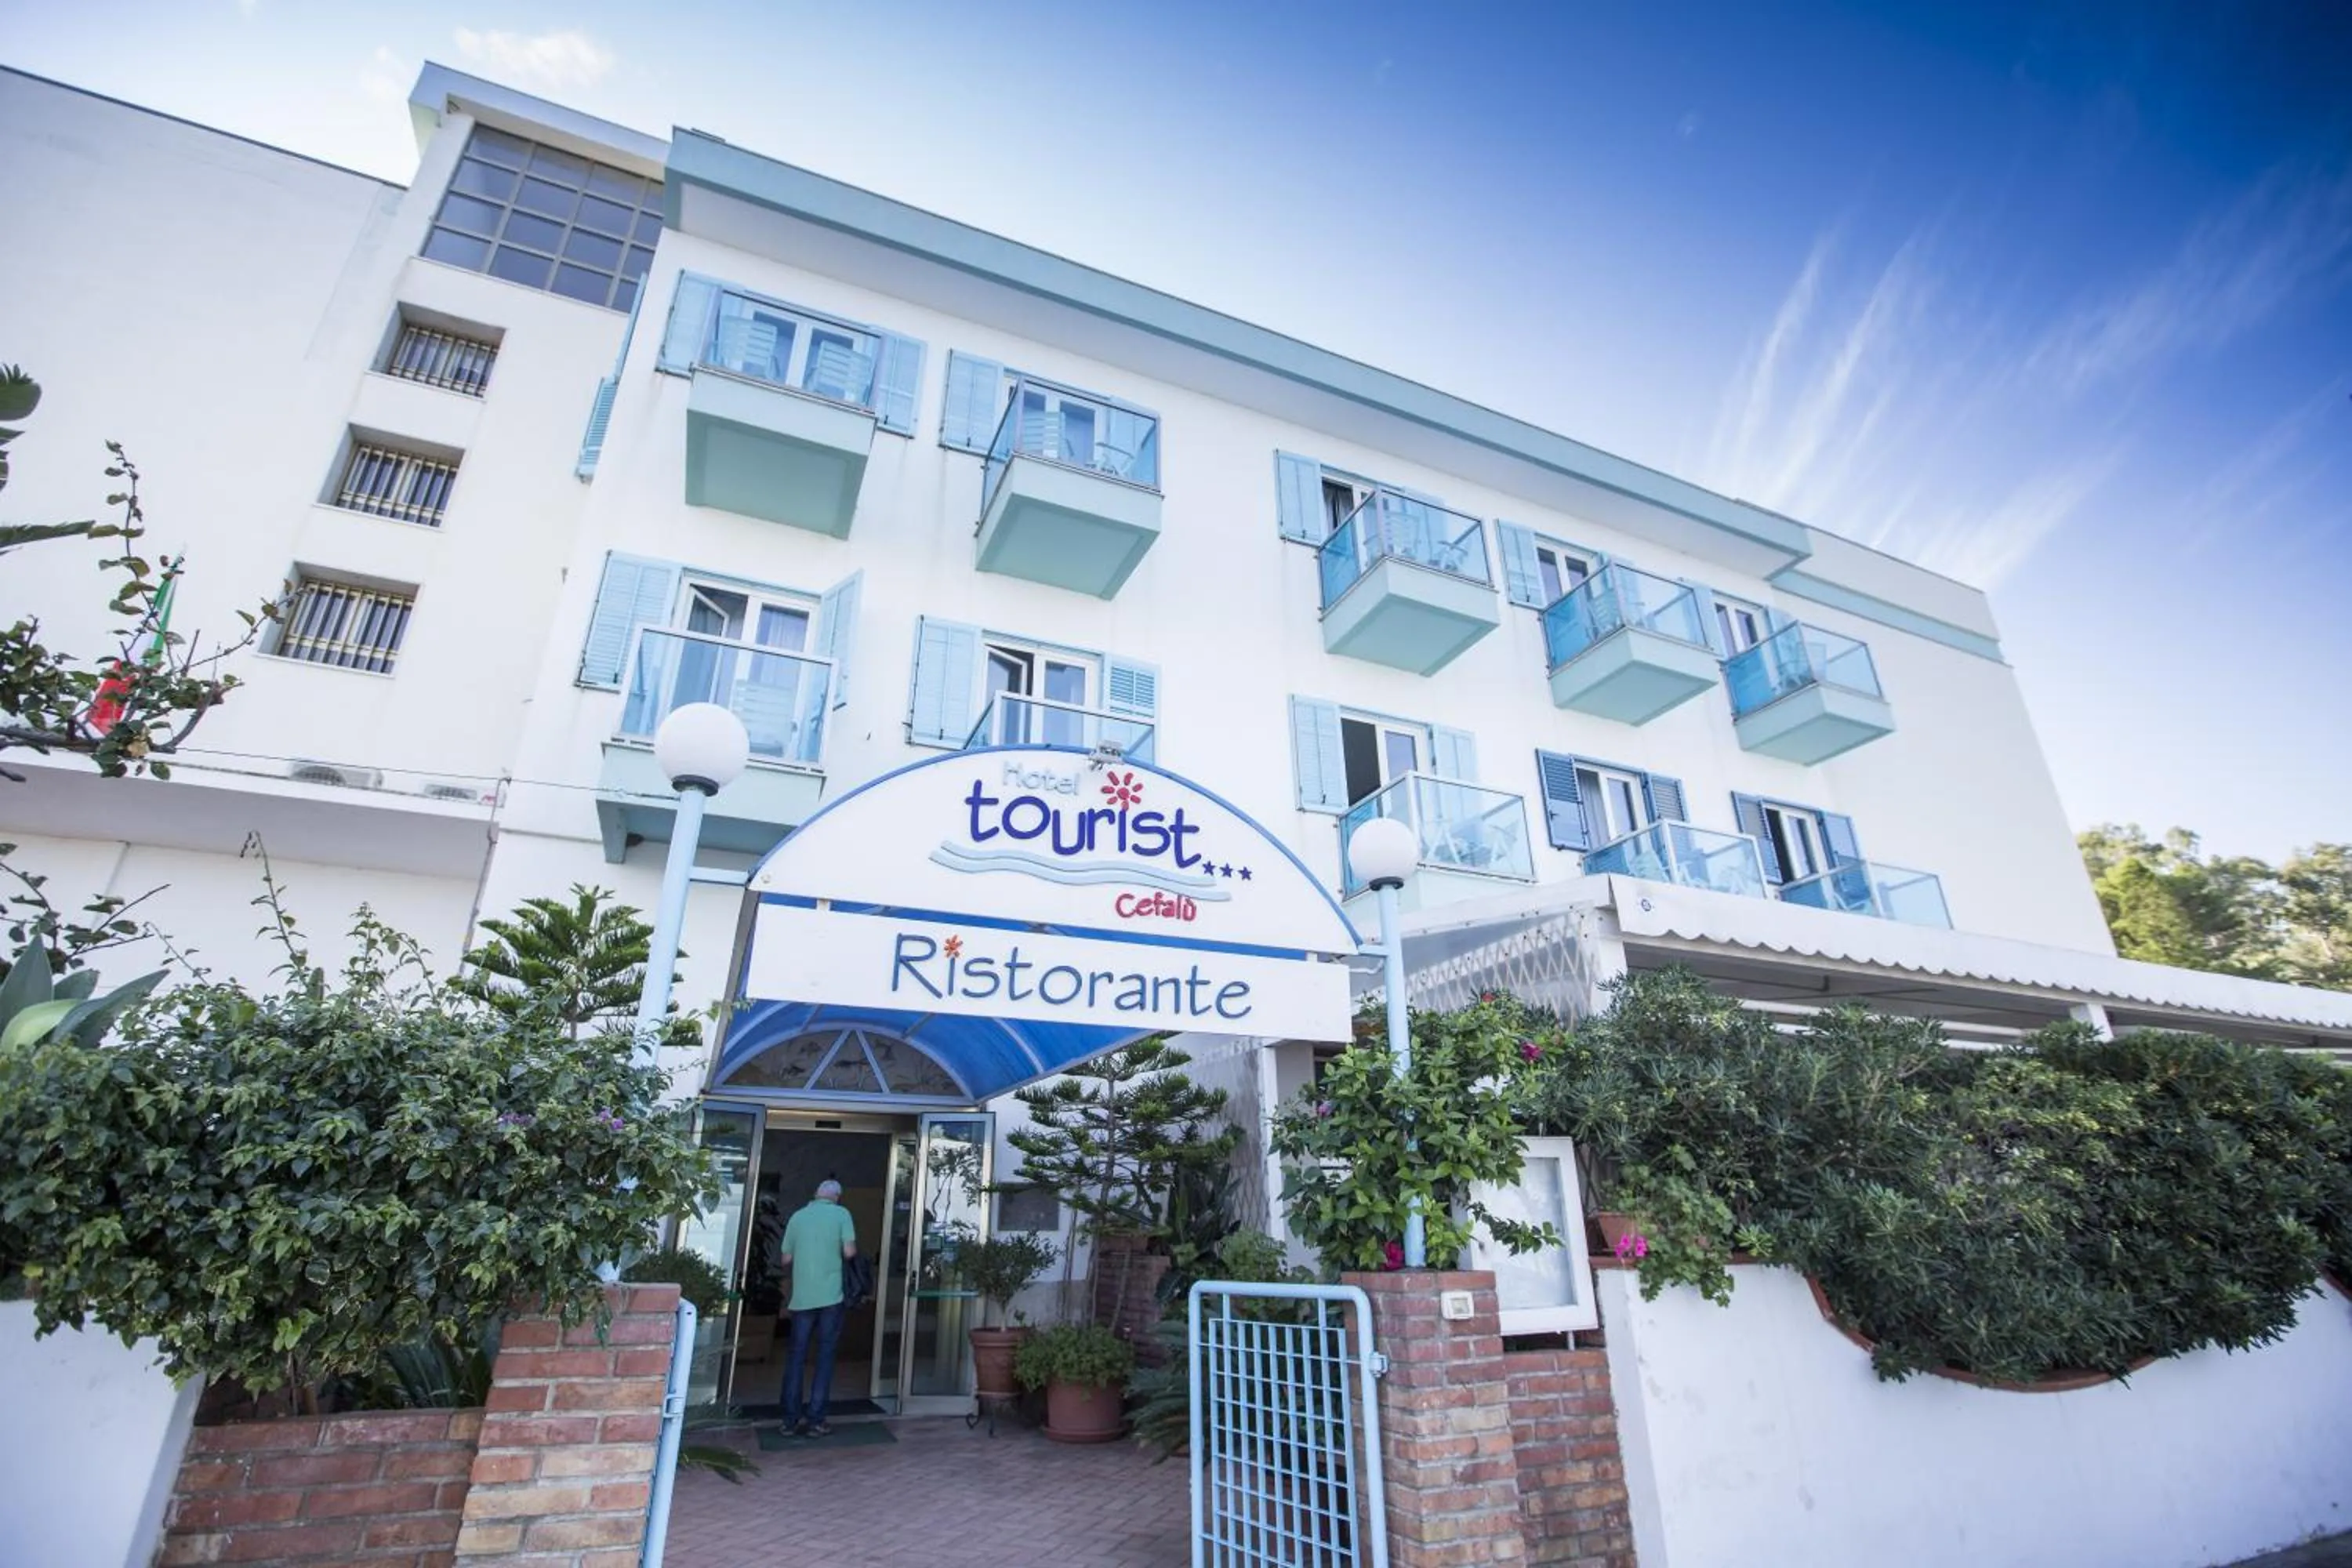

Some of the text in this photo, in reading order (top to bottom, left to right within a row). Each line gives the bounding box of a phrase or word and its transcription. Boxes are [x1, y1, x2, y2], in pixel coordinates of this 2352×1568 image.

[965, 771, 1202, 868] tourist
[1001, 761, 1081, 796] Hotel
[891, 932, 1253, 1020] Ristorante
